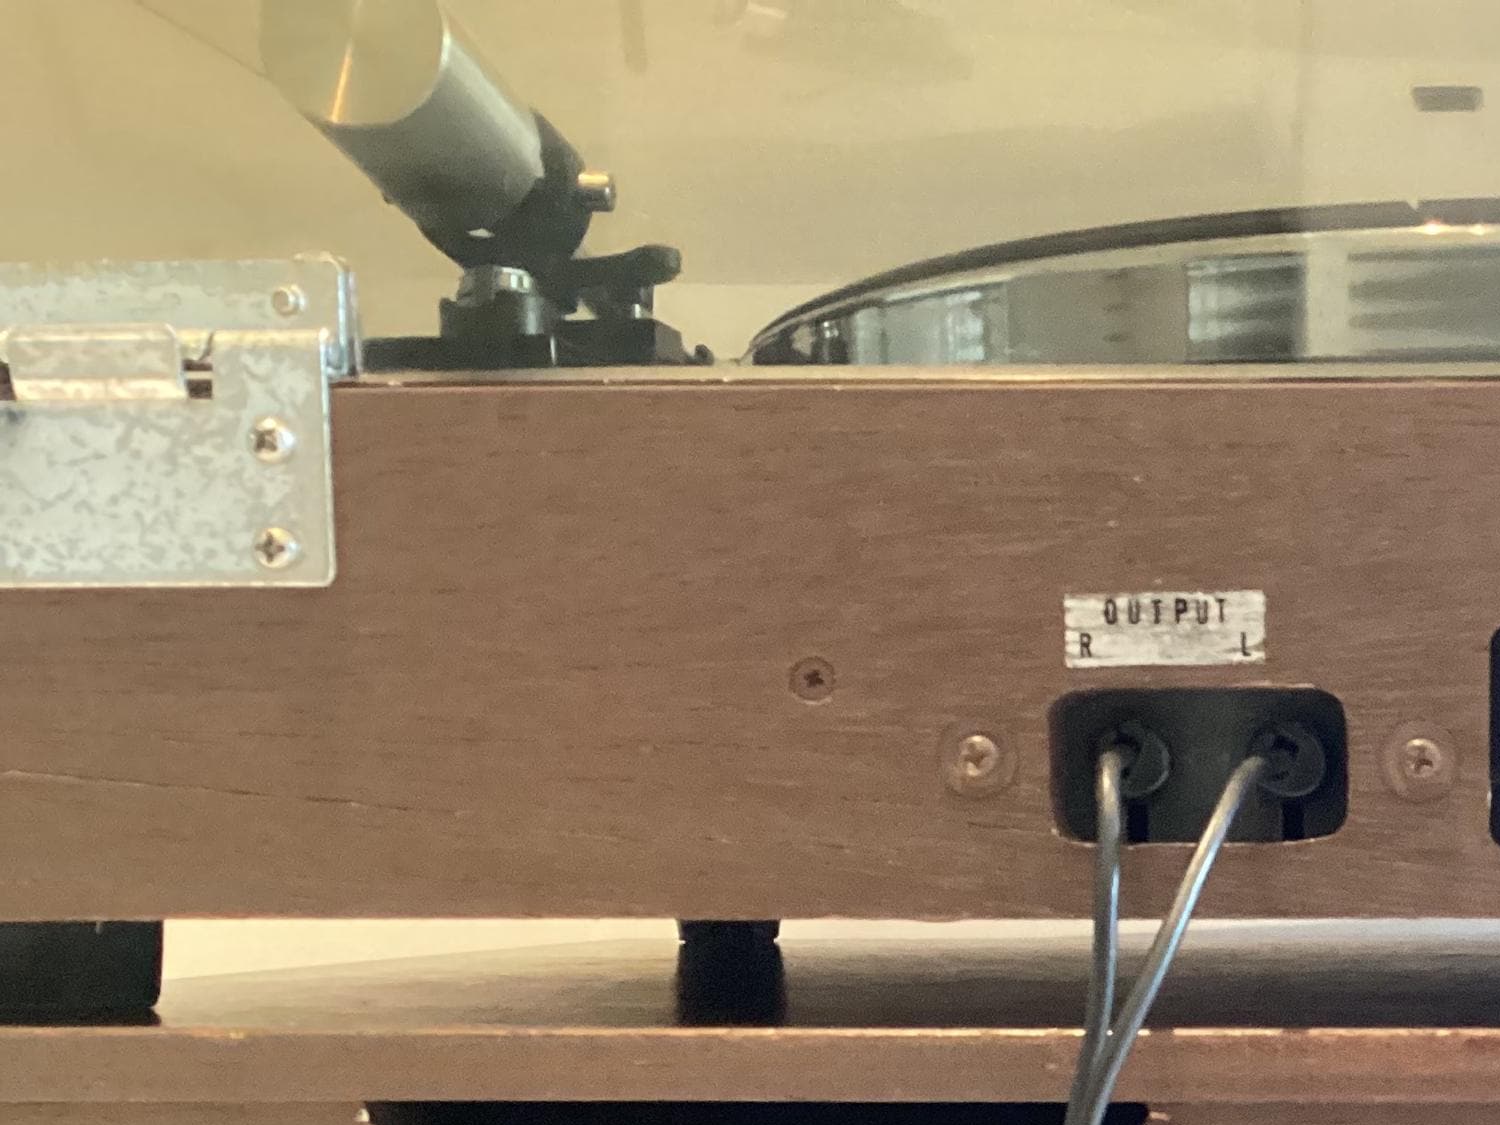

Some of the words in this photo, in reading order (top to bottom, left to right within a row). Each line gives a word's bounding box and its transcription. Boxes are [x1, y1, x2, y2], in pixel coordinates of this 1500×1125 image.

[1103, 597, 1226, 625] OUTPUT
[1079, 632, 1093, 659] R
[1239, 631, 1252, 657] L
